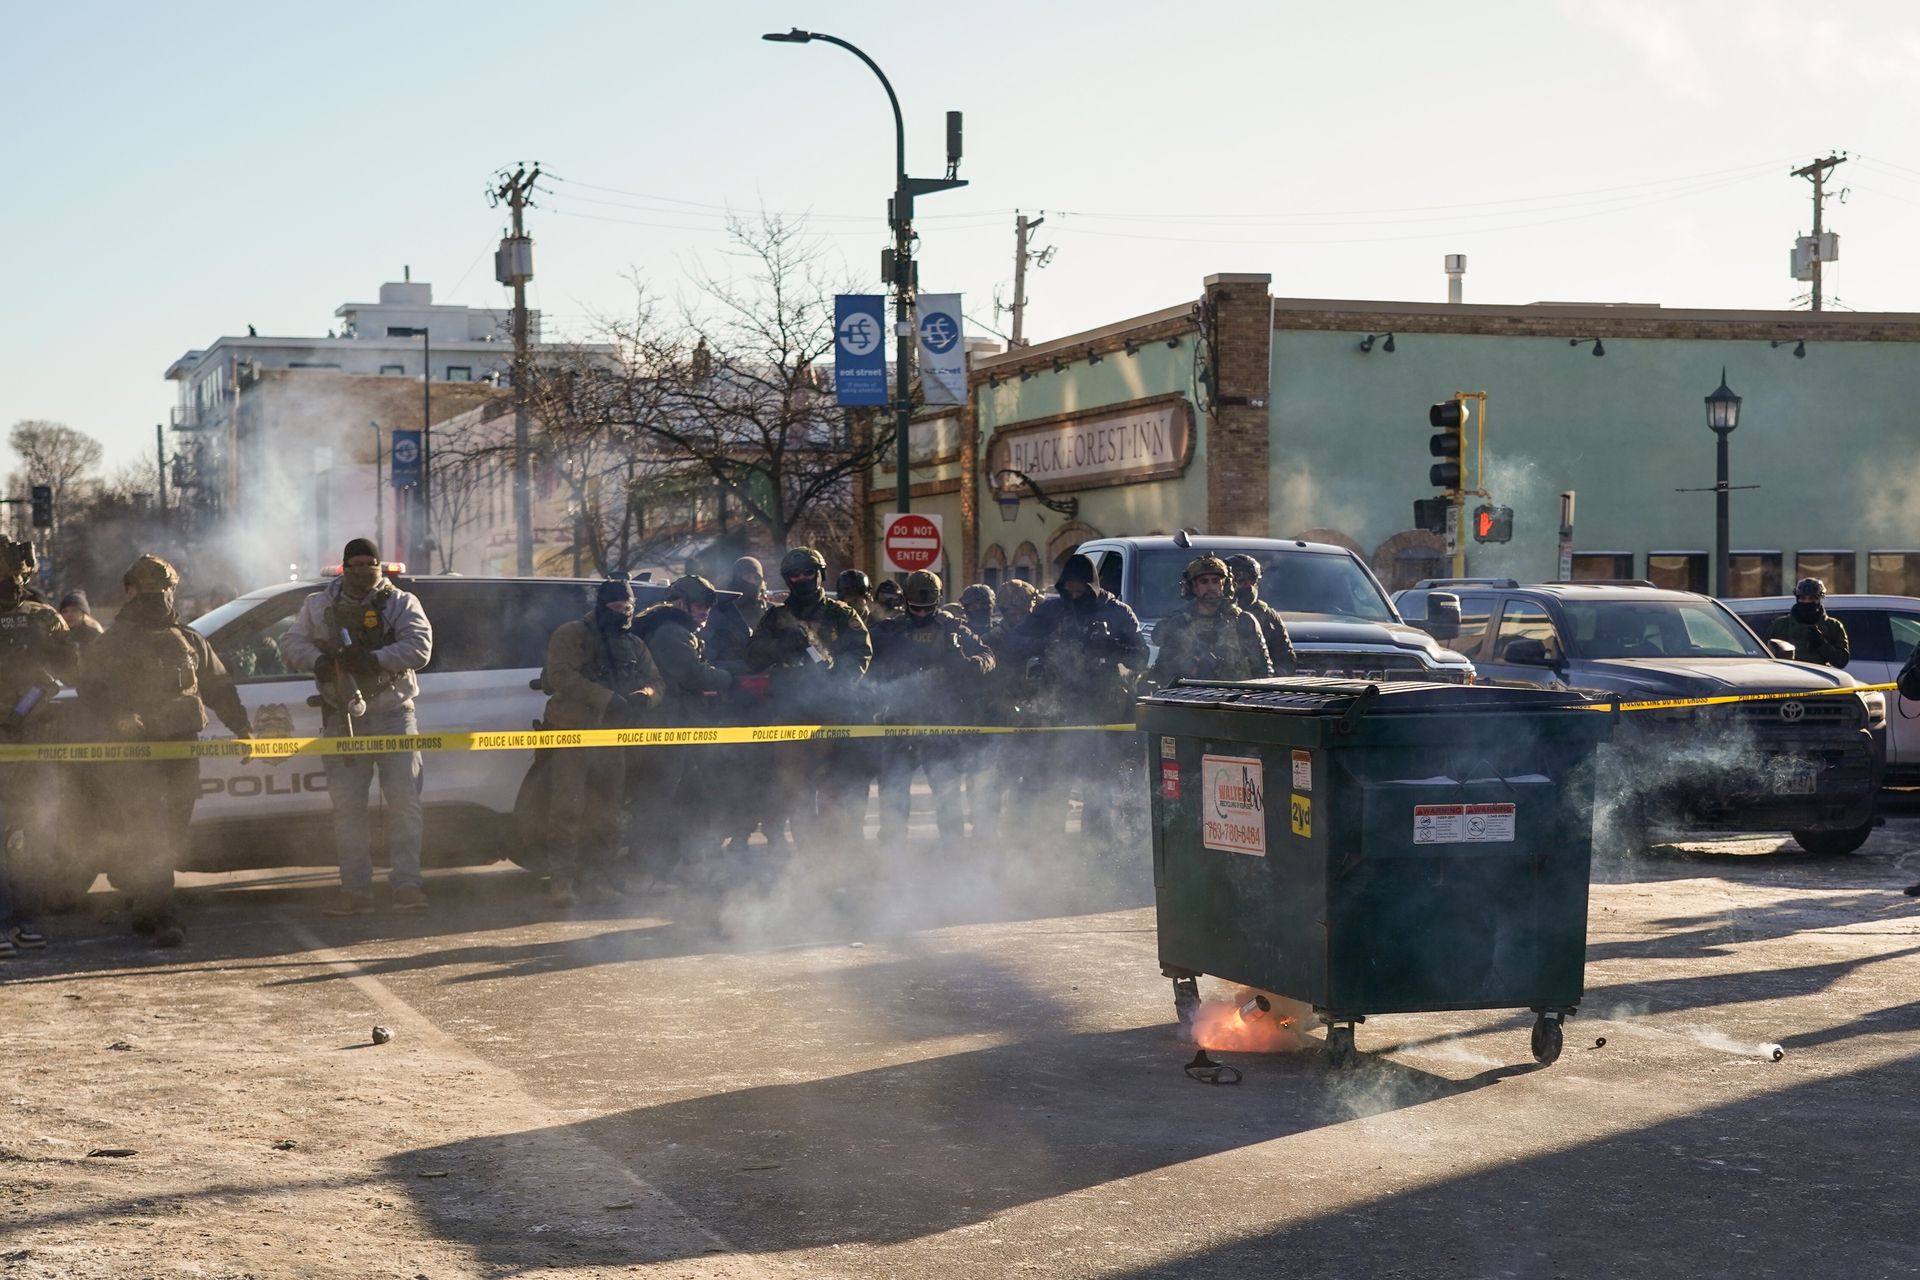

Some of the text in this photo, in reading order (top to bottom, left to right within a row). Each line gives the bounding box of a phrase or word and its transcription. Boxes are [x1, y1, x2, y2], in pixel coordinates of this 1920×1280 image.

[840, 368, 882, 376] eat street
[1015, 419, 1164, 474] BLACK FOREST INN
[893, 526, 933, 535] DO NOT
[896, 551, 929, 561] ENTER
[0, 616, 27, 624] POLCE
[617, 731, 718, 743] POLICE LINE DO NOT CROSS
[752, 730, 778, 740] POLICE
[780, 730, 796, 739] LINE
[798, 730, 808, 739] DO
[810, 729, 825, 739] NOT
[336, 737, 442, 752] POLICE LINE DO NOT CROSS
[479, 734, 581, 747] POLICE LINE DO NOT CROSS
[37, 746, 152, 759] POLICE LINE DO NOT CROSS
[191, 744, 219, 756] POLICE
[221, 744, 240, 756] LINE
[255, 743, 270, 754] NOT
[272, 742, 299, 753] CROSS
[199, 771, 328, 800] POLIC
[1424, 806, 1462, 815] WARNING
[1473, 805, 1513, 814] WARNING
